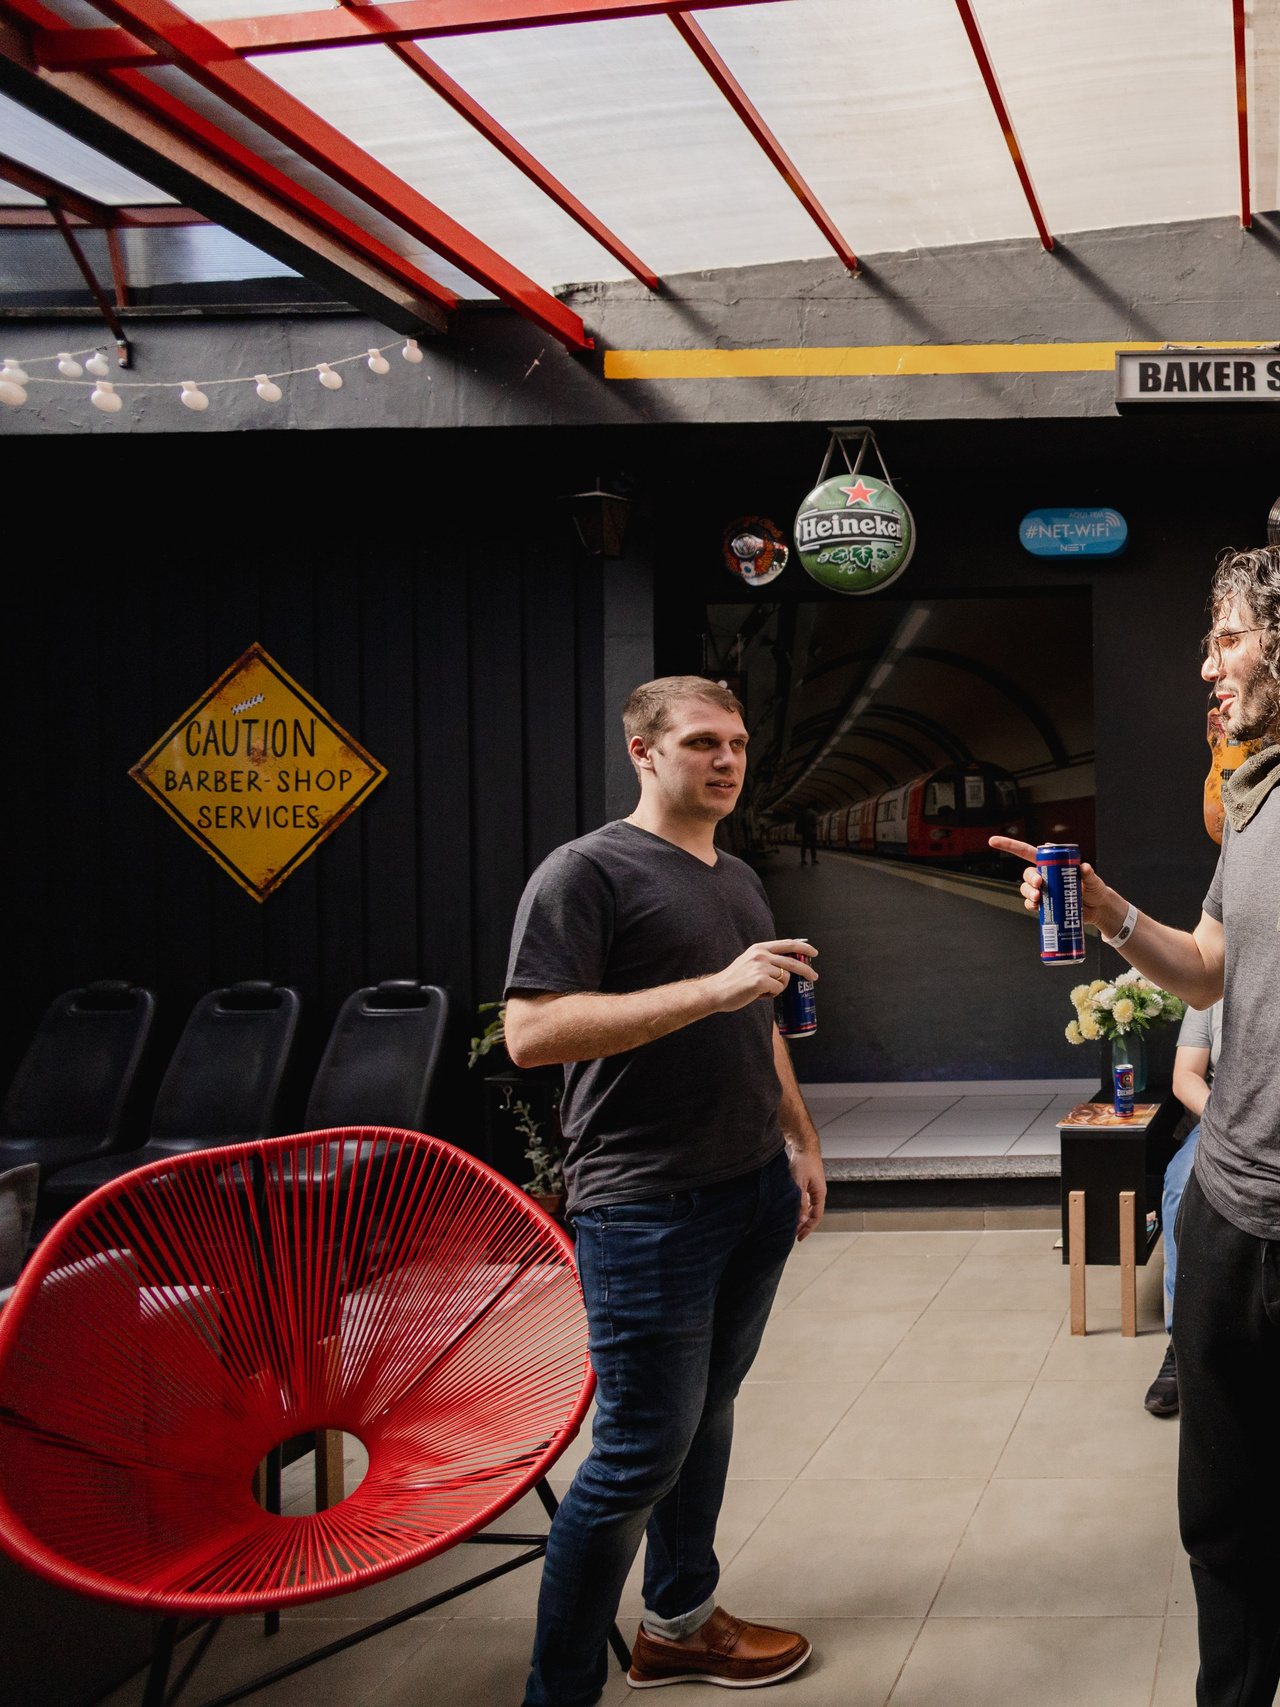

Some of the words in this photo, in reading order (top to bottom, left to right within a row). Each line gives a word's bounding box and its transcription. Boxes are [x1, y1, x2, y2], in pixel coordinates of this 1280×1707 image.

[1138, 361, 1256, 392] BAKER
[1025, 522, 1110, 539] #NET-WiFi
[185, 718, 317, 757] CAUTION
[197, 805, 319, 829] SERVICES
